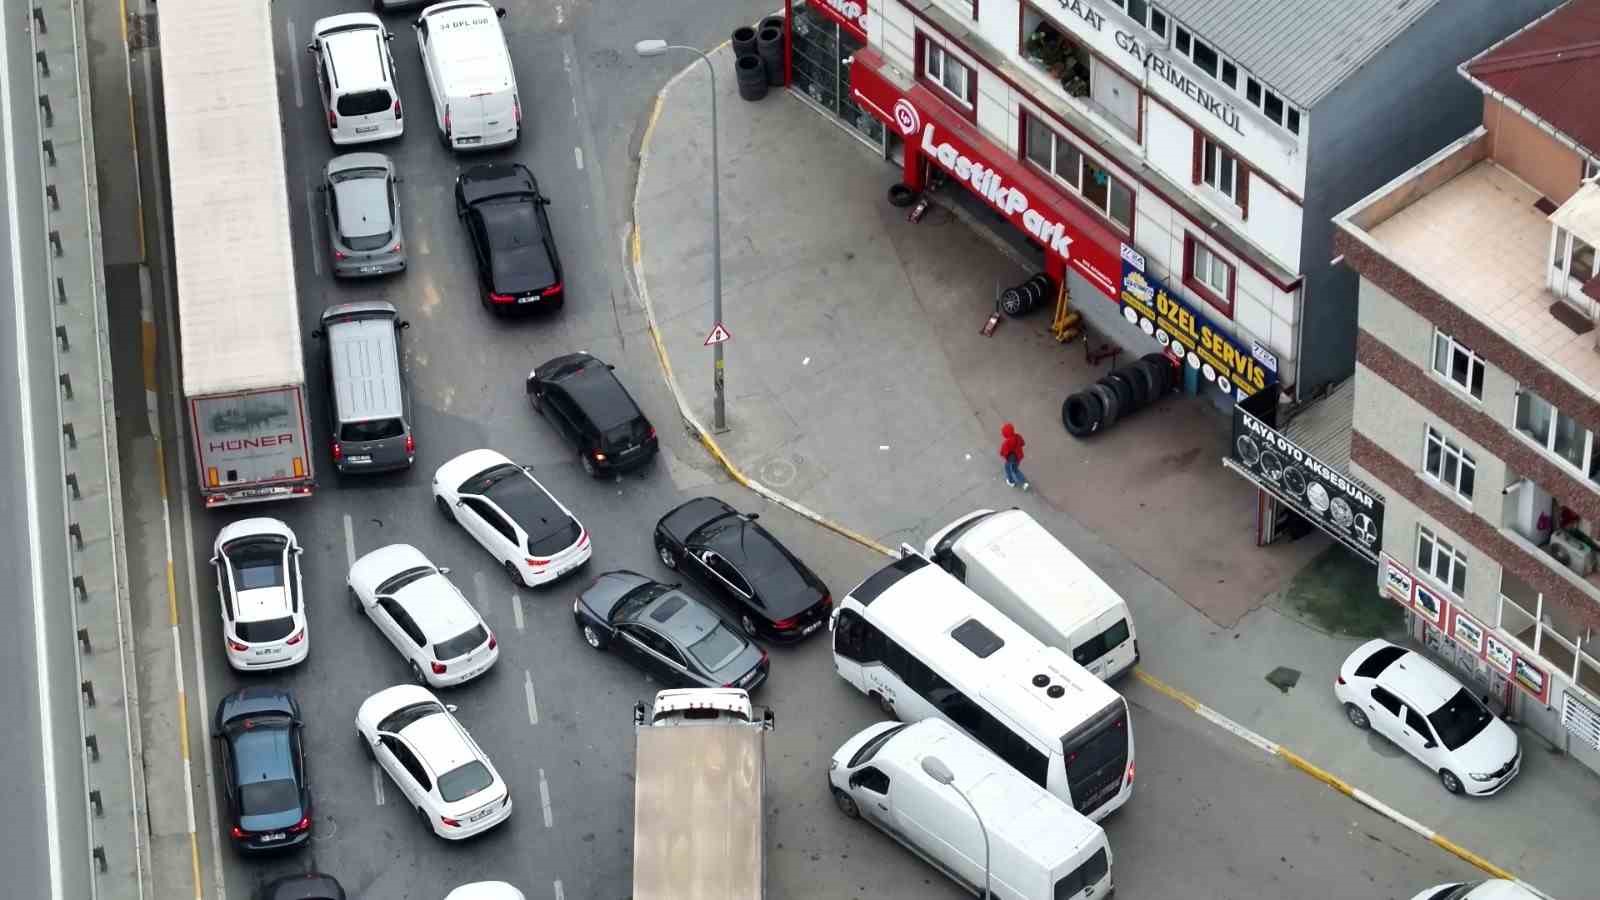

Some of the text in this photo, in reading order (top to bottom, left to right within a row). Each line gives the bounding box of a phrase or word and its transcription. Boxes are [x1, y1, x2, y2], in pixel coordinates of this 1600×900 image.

[922, 123, 1073, 259] LastikPark
[1156, 289, 1199, 340] ÖZEL
[1201, 326, 1265, 389] SERVİS
[1243, 415, 1275, 445] KAYA
[1277, 438, 1303, 462] OTO
[1305, 457, 1374, 509] AKSESUAR
